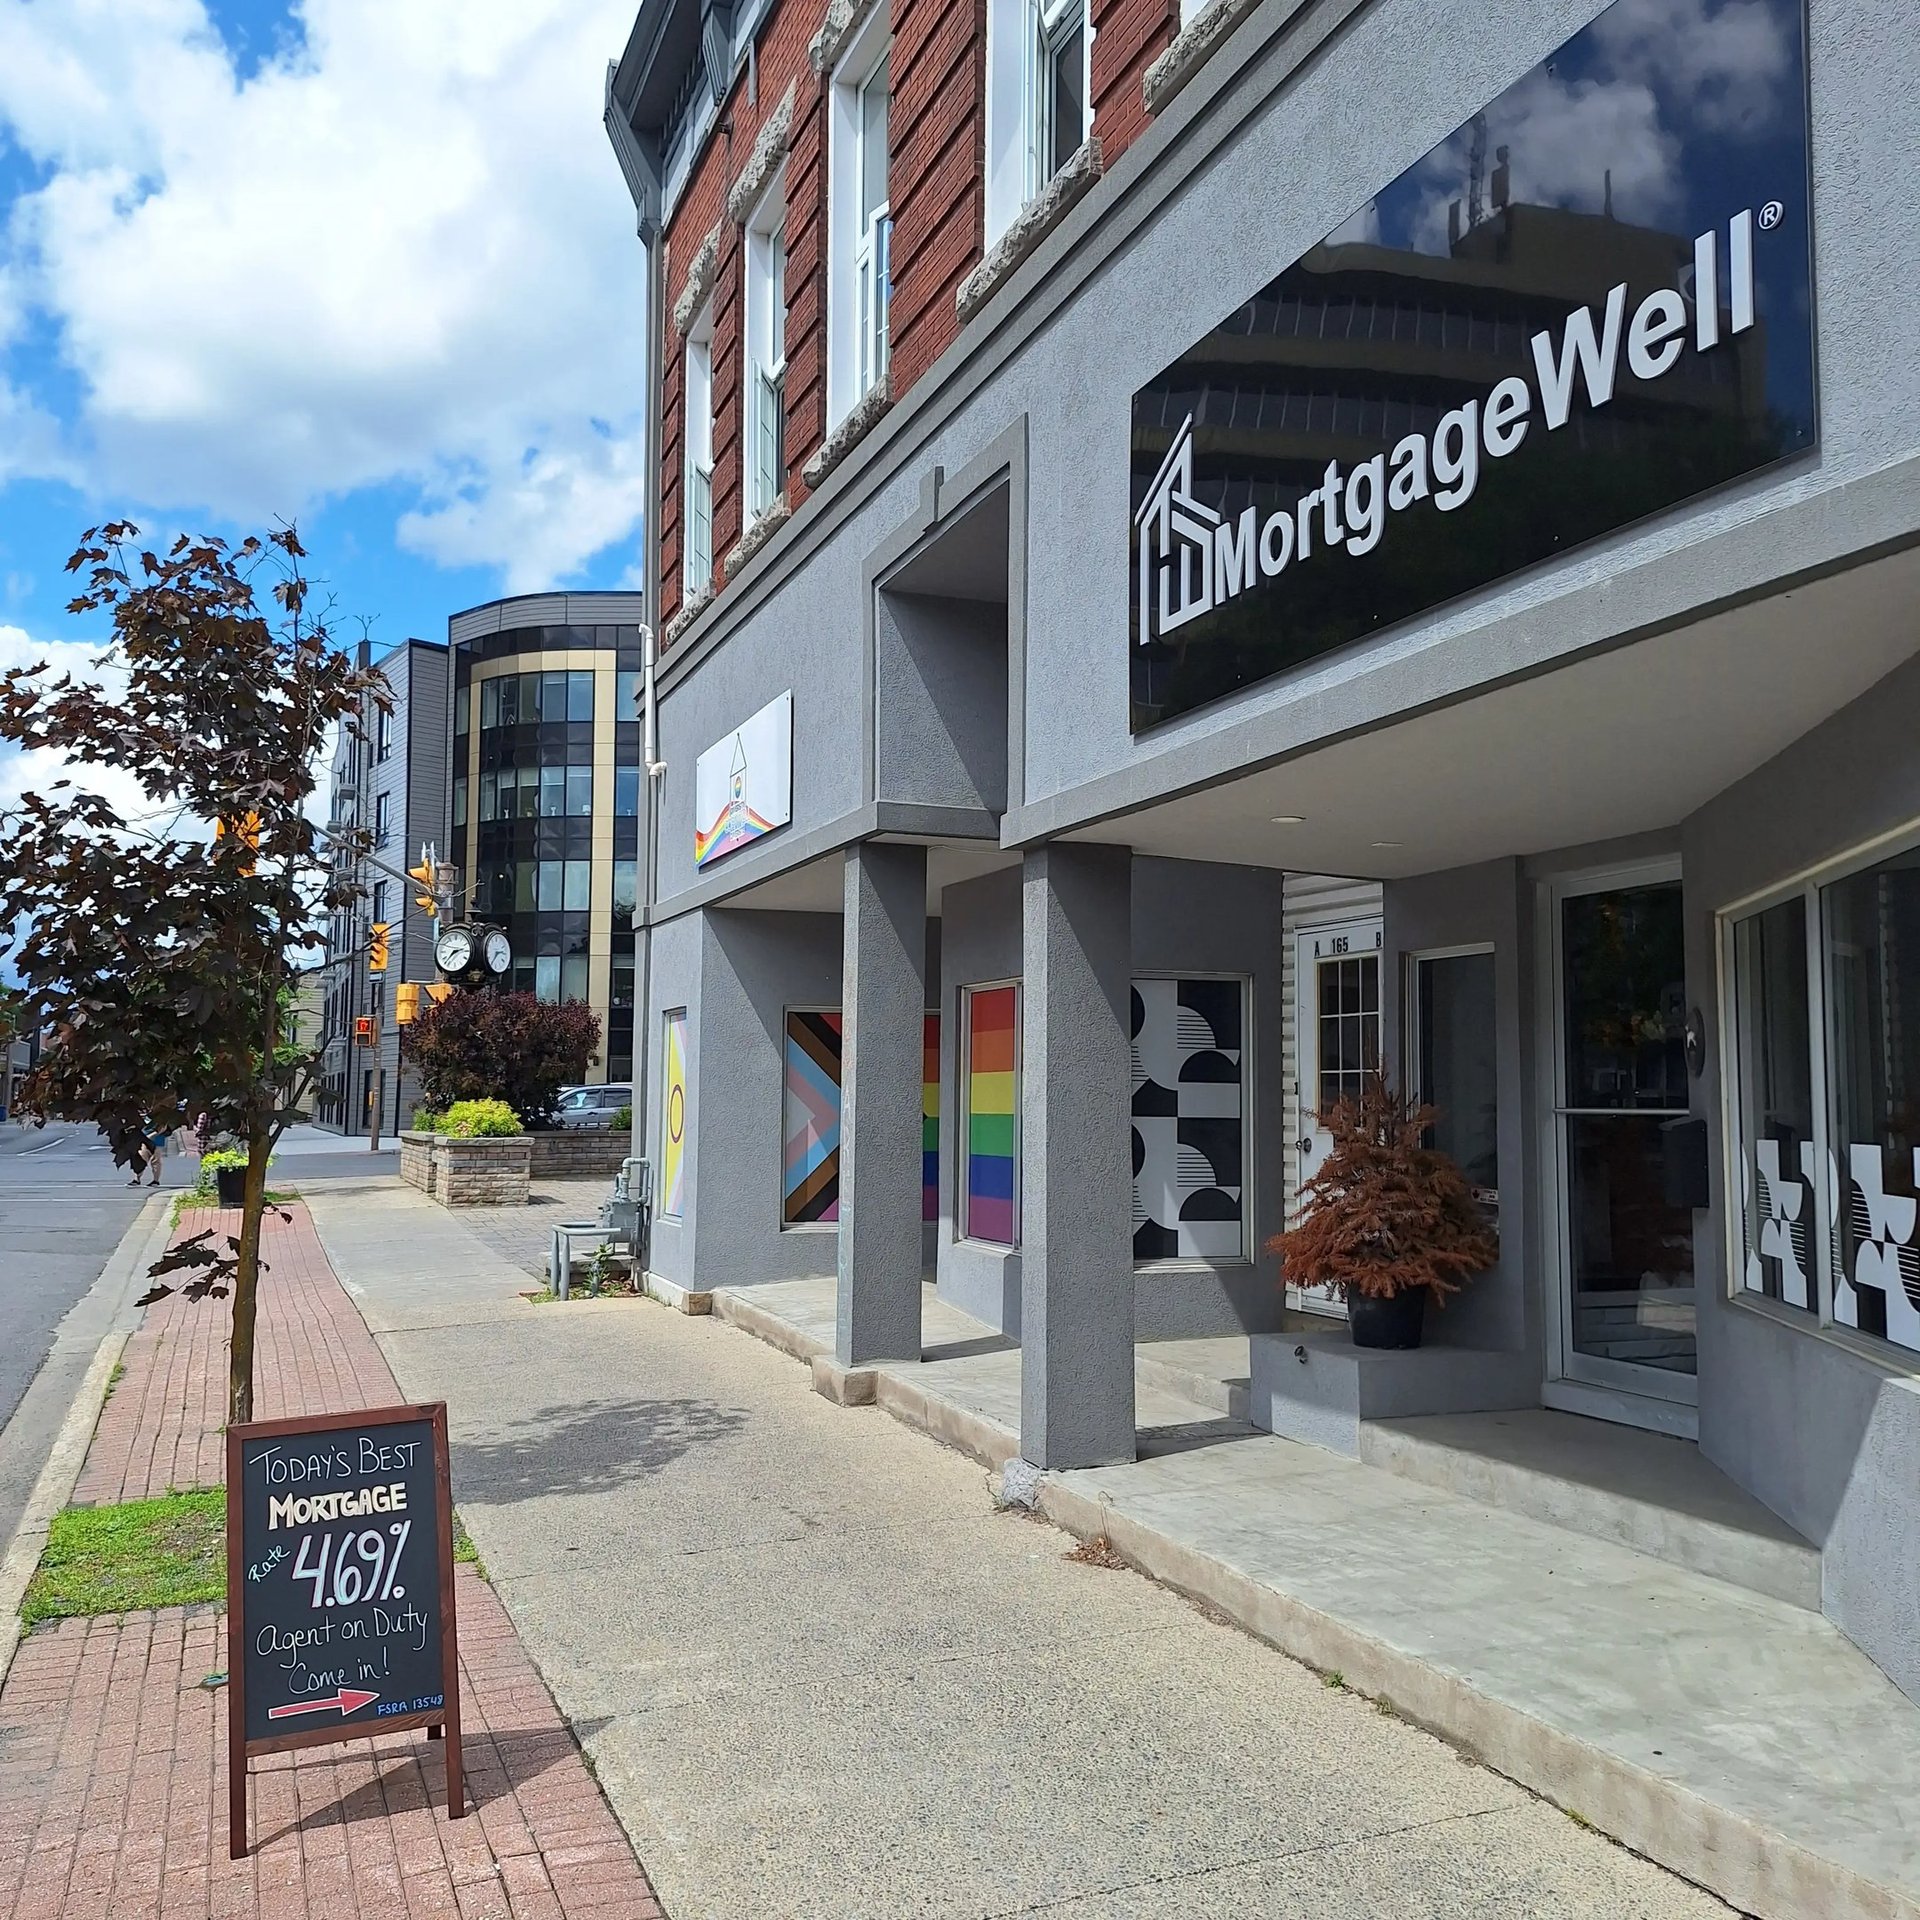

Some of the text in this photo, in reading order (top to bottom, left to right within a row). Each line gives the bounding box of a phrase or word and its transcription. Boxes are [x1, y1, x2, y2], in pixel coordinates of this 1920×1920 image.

[1314, 932, 1382, 957] A 165 B
[249, 1437, 422, 1486] TODAY'S BEST
[268, 1482, 408, 1531] MORTGAGE
[248, 1519, 412, 1609] Rate 4.69%
[341, 1619, 369, 1639] on
[373, 1602, 429, 1651] Duty
[288, 1662, 352, 1694] Come
[377, 1694, 444, 1716] FSRA 13548
